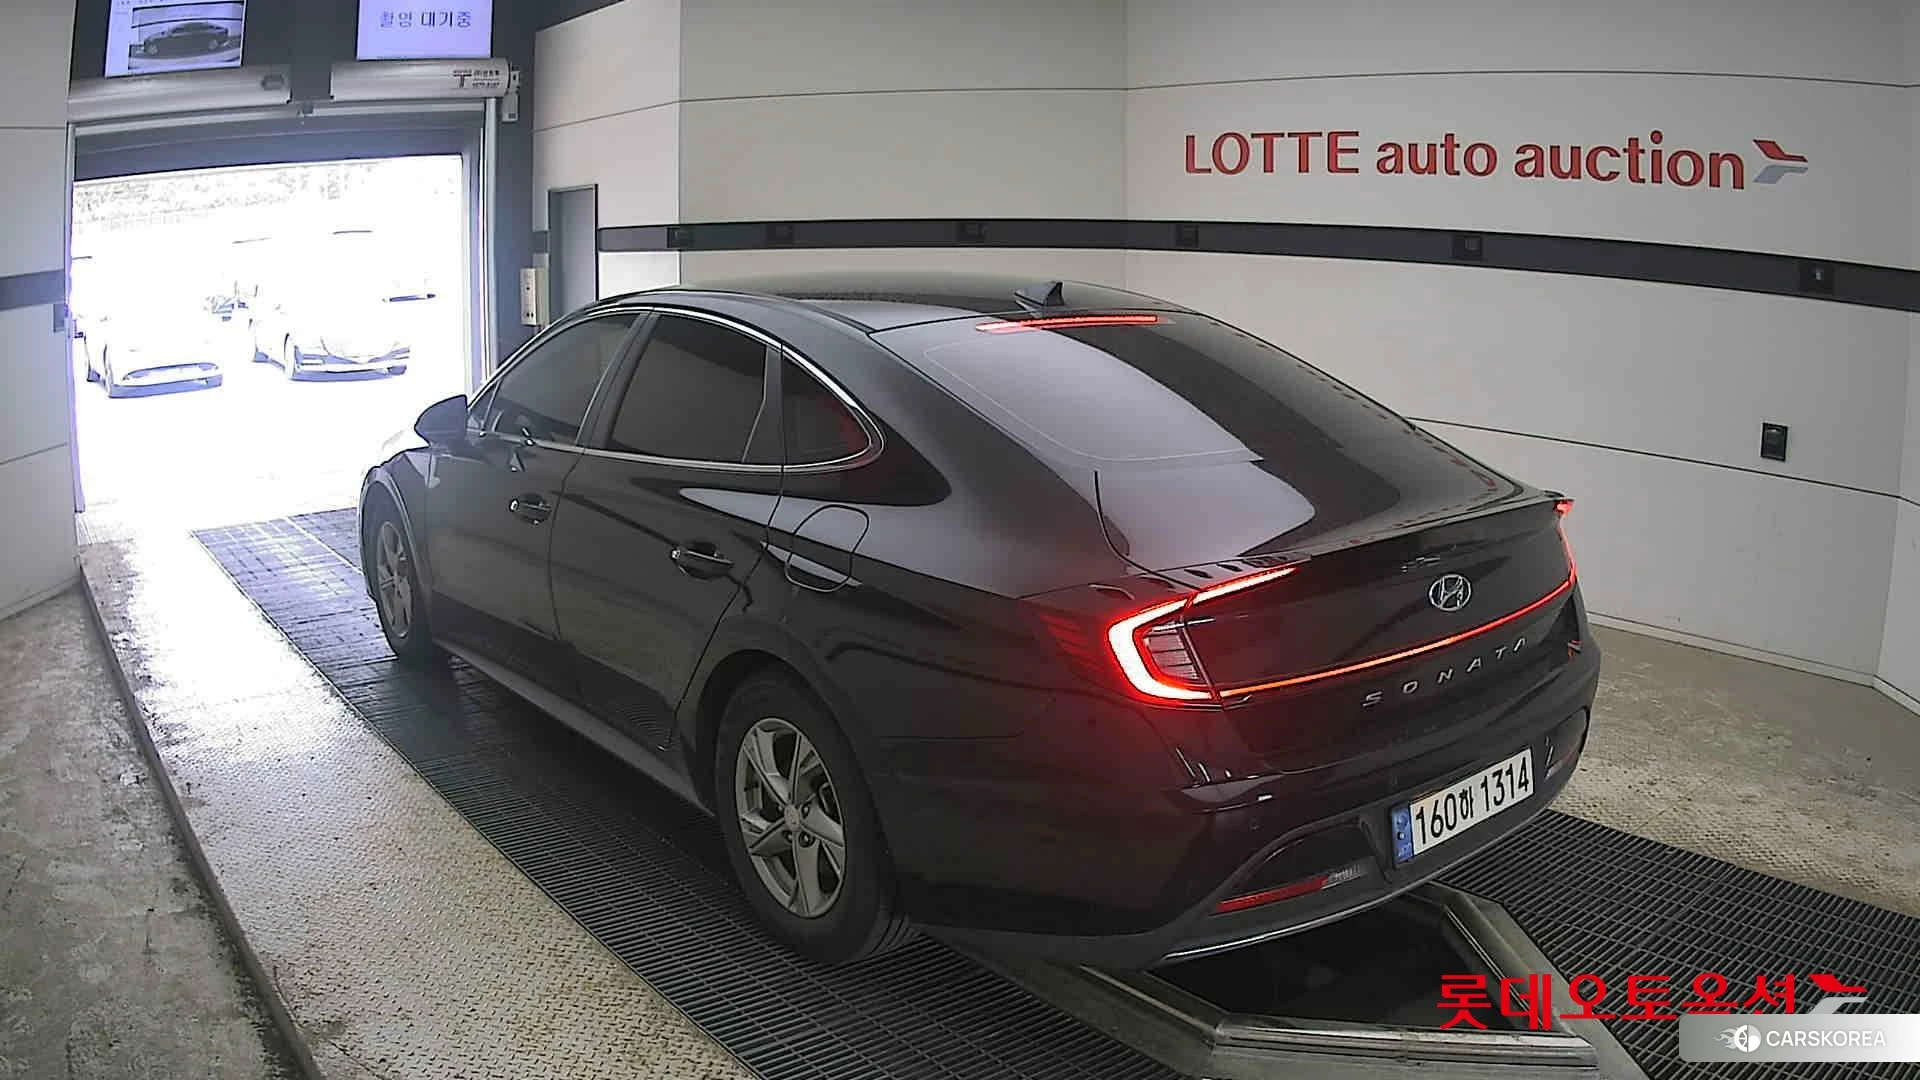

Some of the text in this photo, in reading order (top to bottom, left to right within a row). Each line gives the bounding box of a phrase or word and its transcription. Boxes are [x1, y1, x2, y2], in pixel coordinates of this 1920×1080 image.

[421, 10, 472, 28] 대기중
[1185, 130, 1745, 190] LOTTE auto auction
[1362, 637, 1527, 707] SONATA
[1415, 756, 1530, 845] 160하 1314
